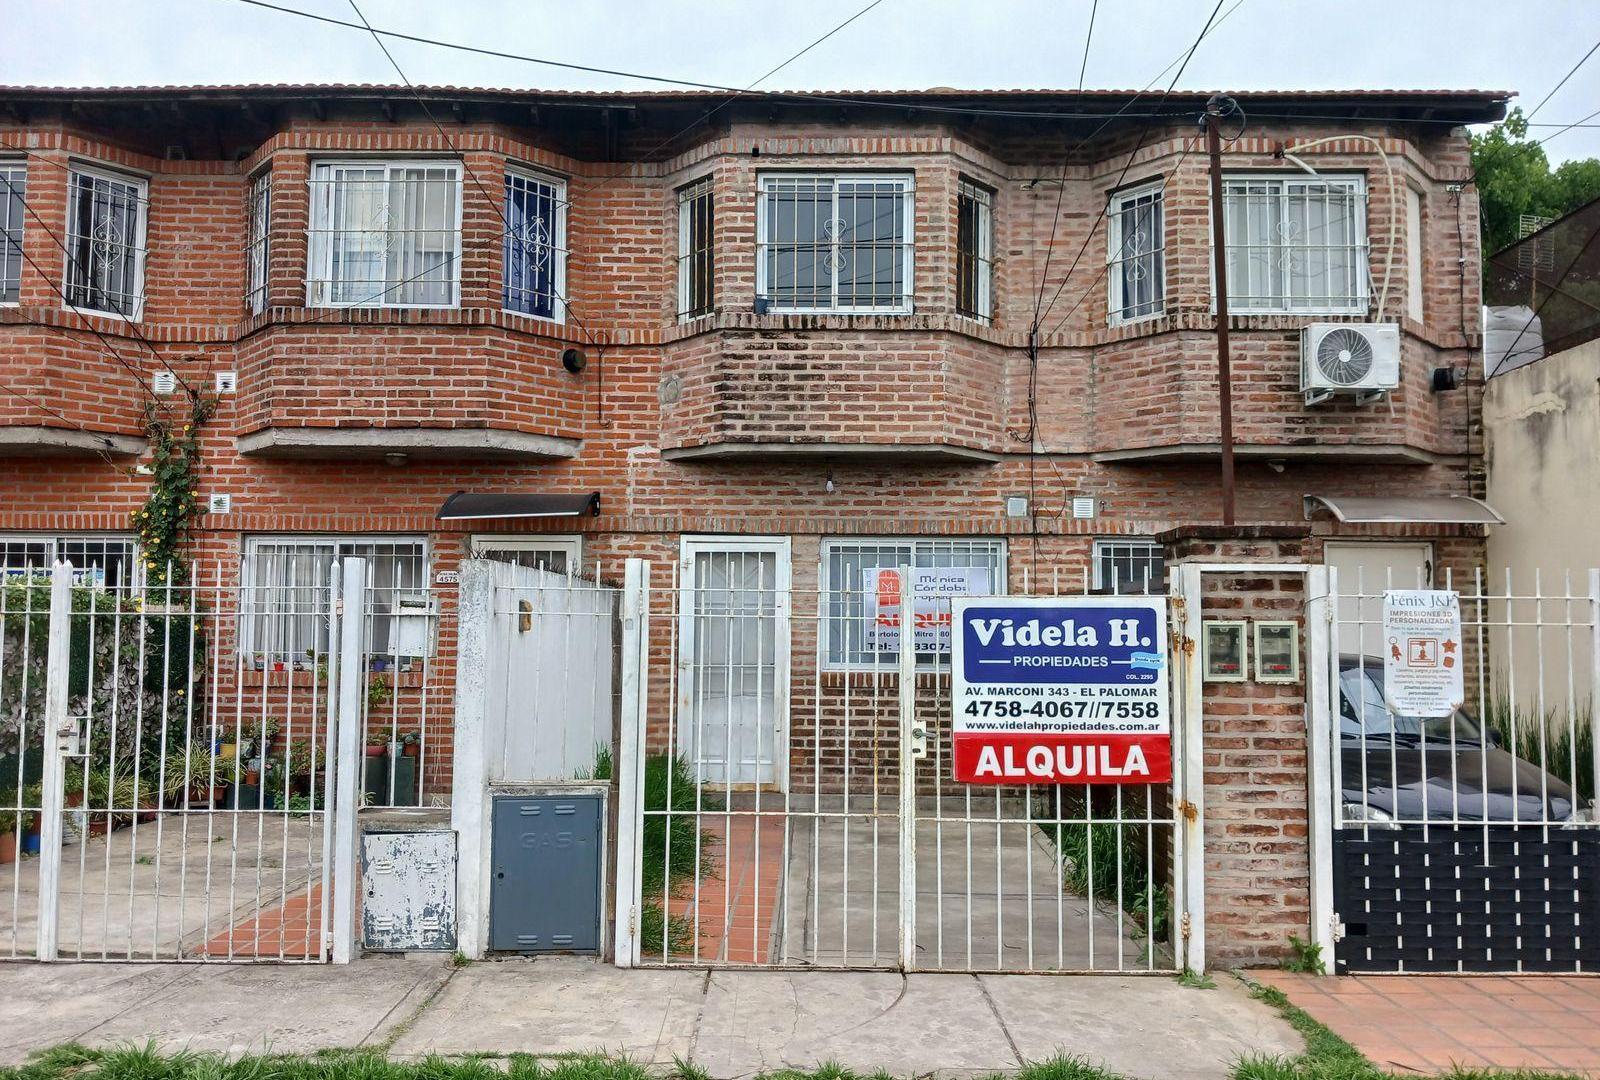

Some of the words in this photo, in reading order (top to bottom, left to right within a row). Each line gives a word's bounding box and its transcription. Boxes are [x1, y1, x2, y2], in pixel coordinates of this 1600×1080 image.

[1391, 594, 1426, 607] Fénix
[969, 618, 1099, 647] Videla
[1108, 618, 1151, 647] H.
[1013, 656, 1109, 668] PROPIEDADES
[965, 687, 983, 697] AV.
[988, 687, 1044, 697] MARCONI
[1047, 687, 1069, 697] 343
[1080, 688, 1095, 697] EL
[1100, 688, 1158, 697] PALOMAR
[964, 700, 1160, 718] 4758-4067//7558
[965, 720, 1160, 732] www.videlahpropiedades.com.ar
[974, 745, 1151, 779] ALQUILA
